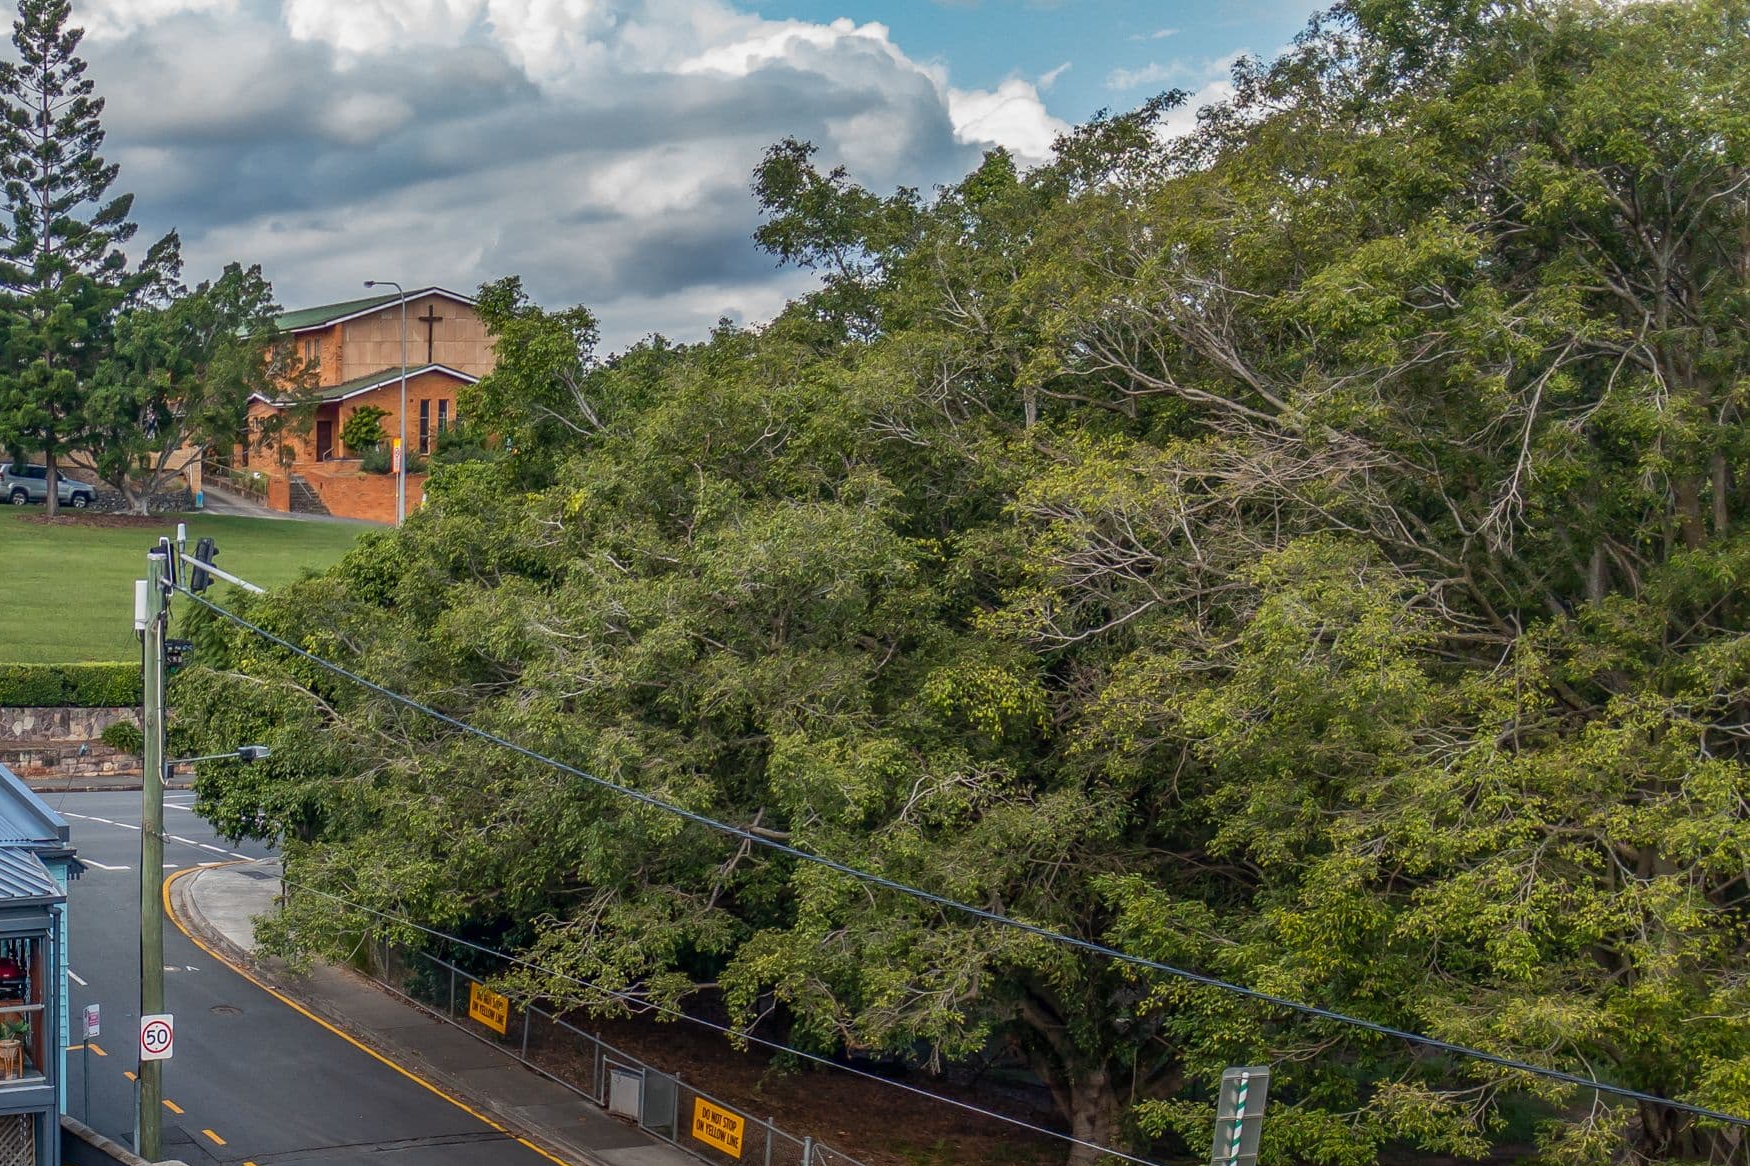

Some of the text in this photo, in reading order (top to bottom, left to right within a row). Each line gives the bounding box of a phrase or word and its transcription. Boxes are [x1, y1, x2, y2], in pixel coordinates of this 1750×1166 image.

[479, 1004, 496, 1020] YELLOW
[146, 1029, 168, 1046] 50
[702, 1106, 737, 1131] DO NOT STOP
[696, 1118, 739, 1149] ON YELLOW LINE
